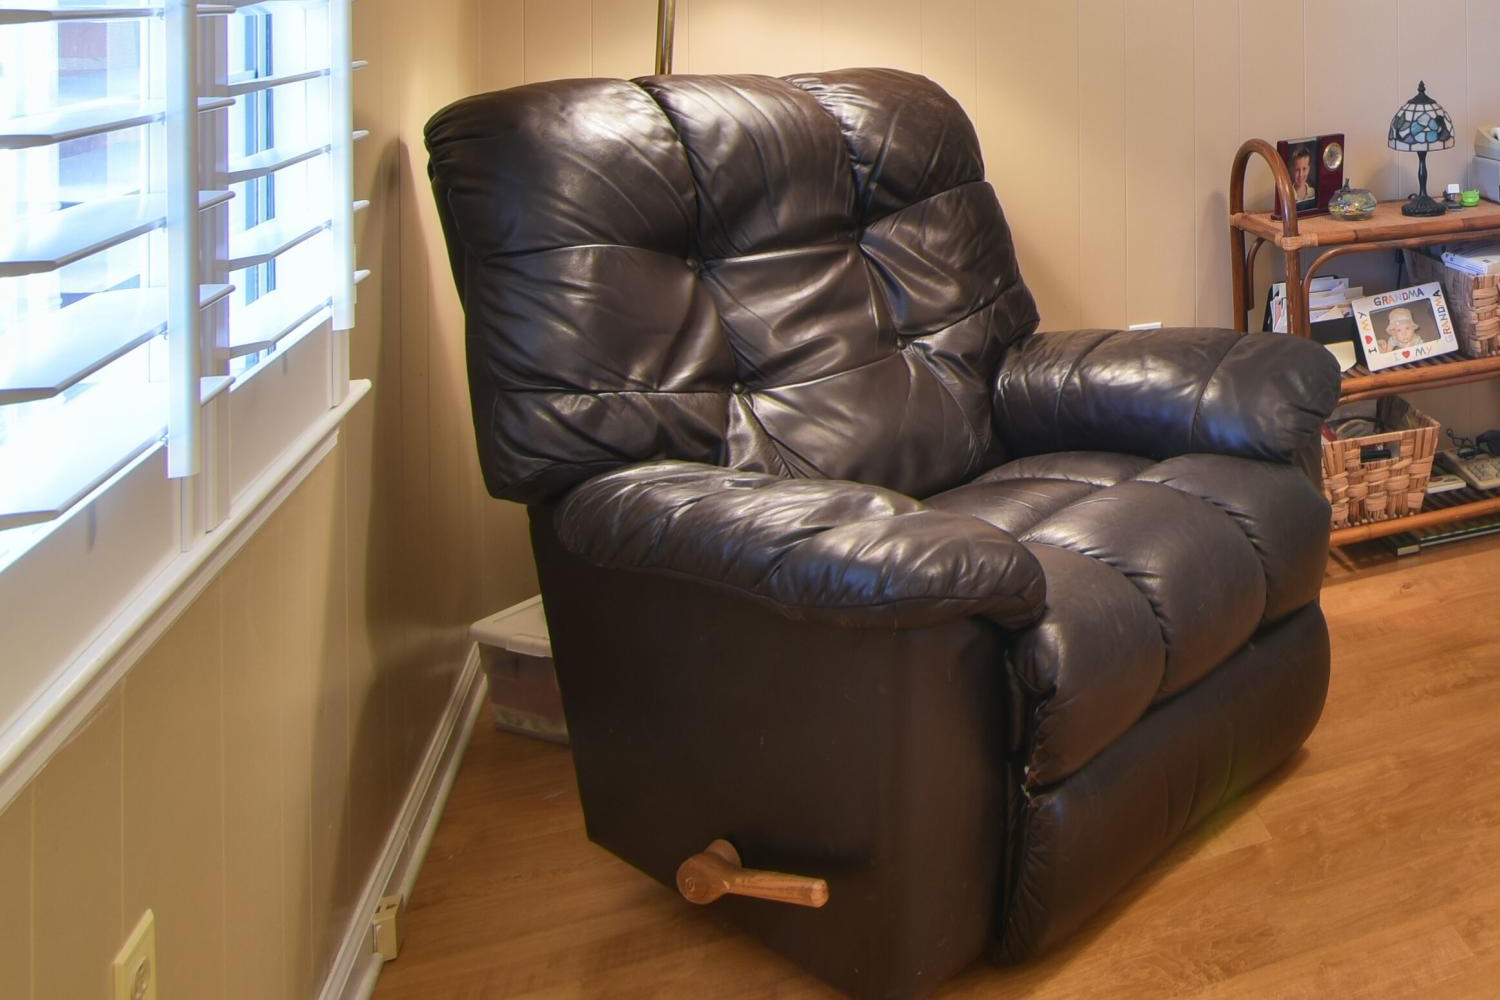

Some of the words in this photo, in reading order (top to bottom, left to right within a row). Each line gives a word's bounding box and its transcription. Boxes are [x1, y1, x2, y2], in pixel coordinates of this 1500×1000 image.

[1374, 288, 1424, 306] GRANDMA
[1358, 311, 1371, 331] MY
[1433, 289, 1454, 343] GRANDMA
[1415, 346, 1432, 357] MY
